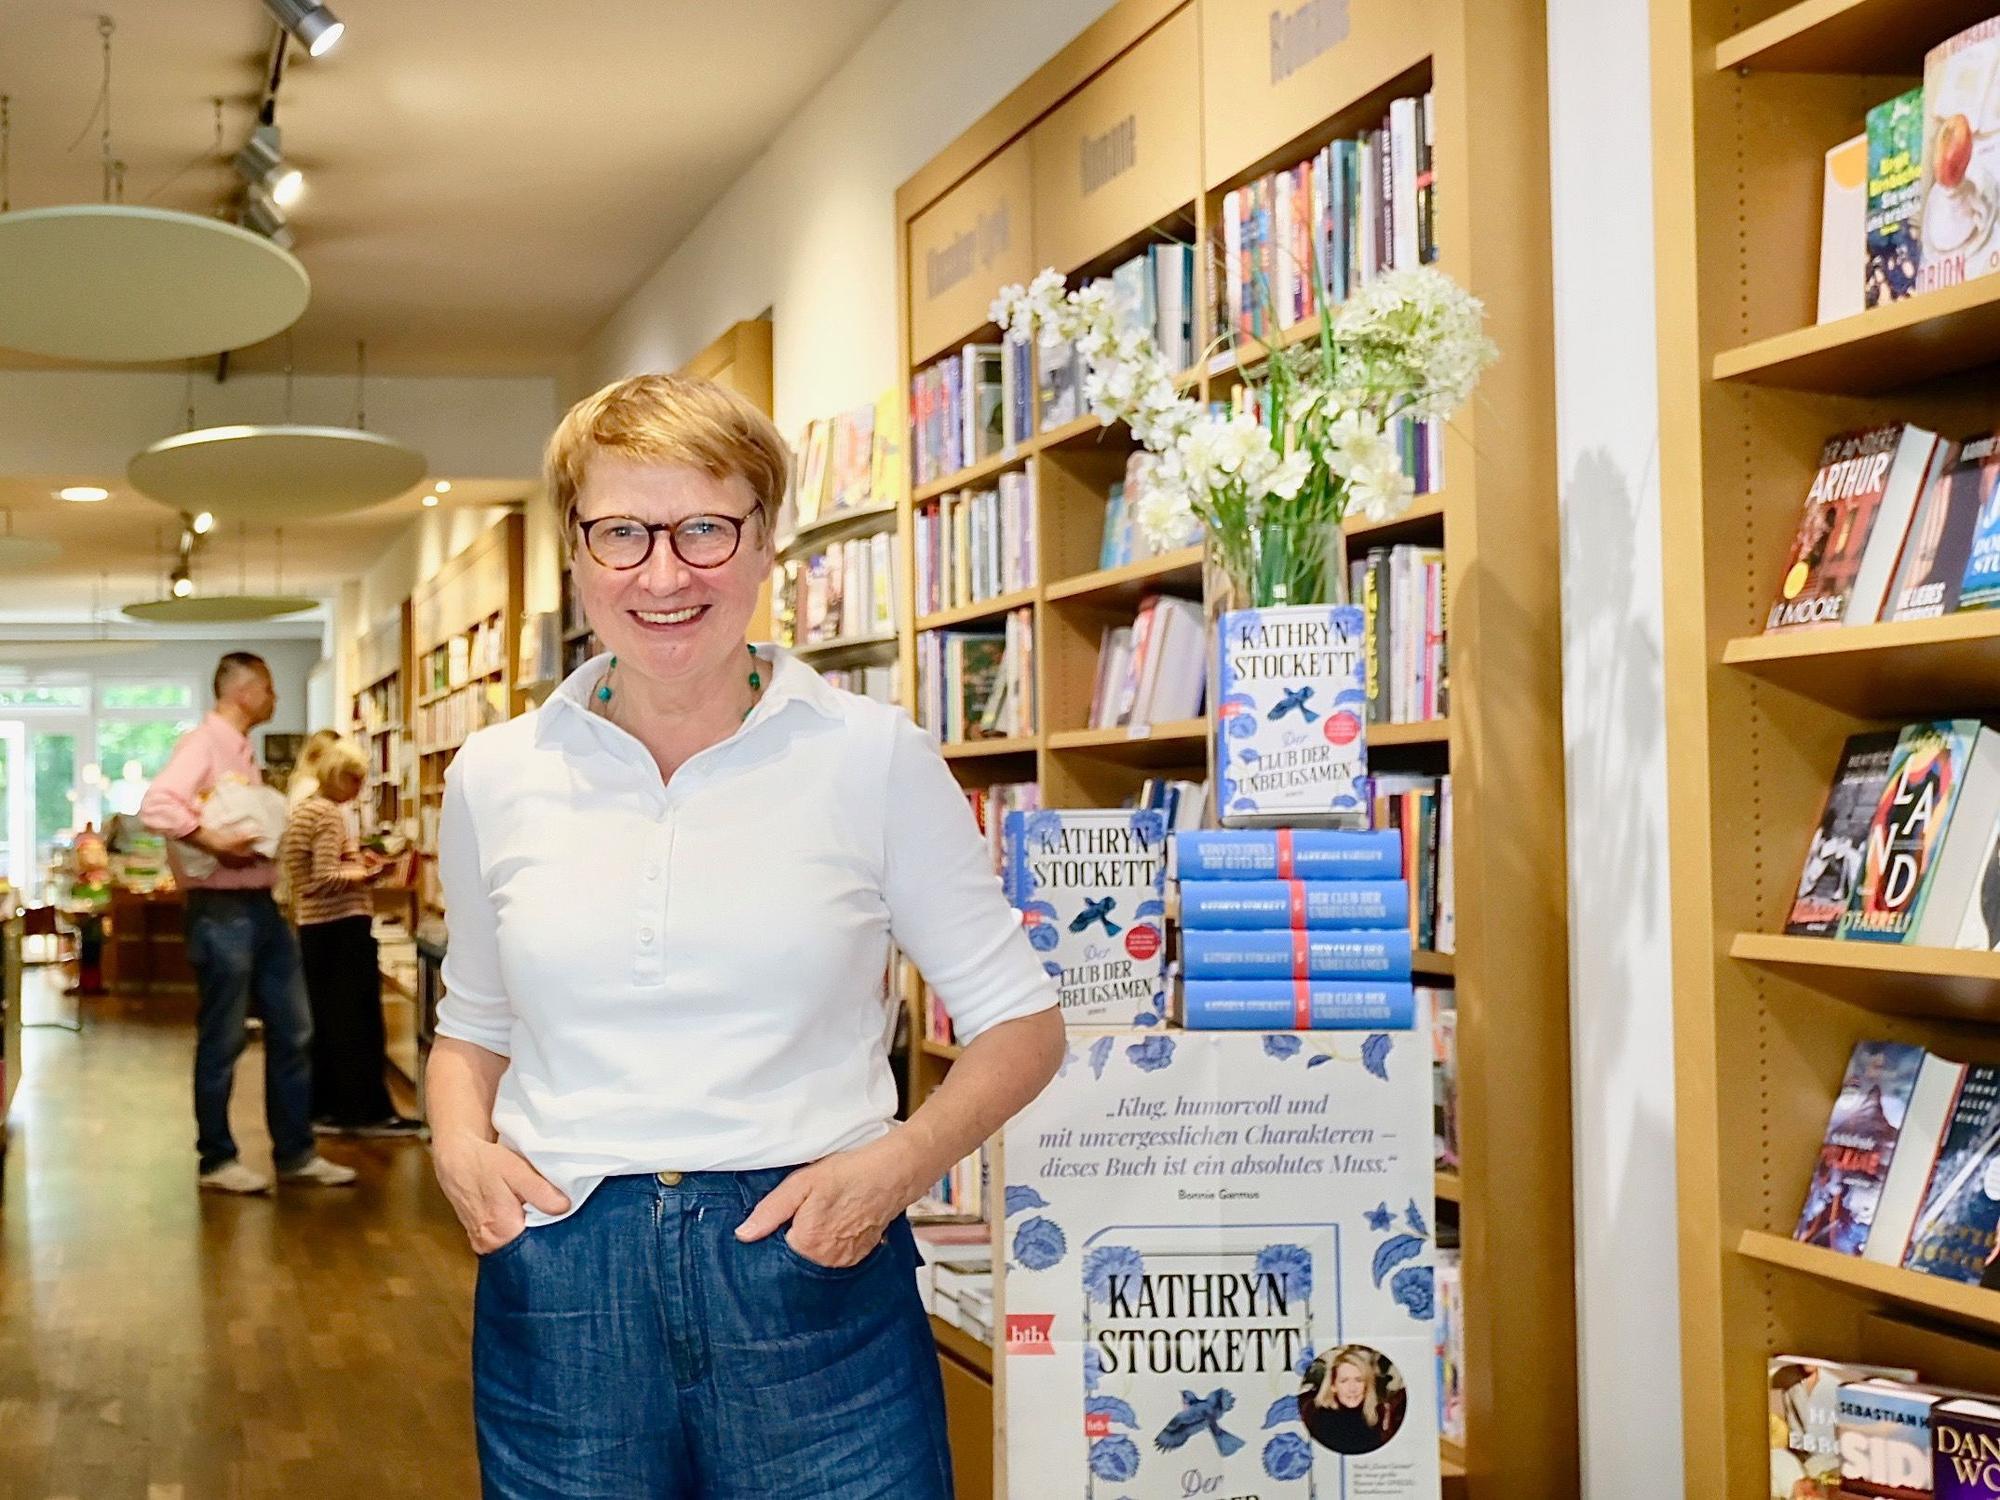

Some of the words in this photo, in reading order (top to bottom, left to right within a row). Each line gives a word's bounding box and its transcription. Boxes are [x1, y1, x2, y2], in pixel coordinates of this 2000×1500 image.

[1804, 451, 1890, 508] ARTHUR
[1242, 620, 1350, 650] KATHRYN
[1235, 652, 1356, 681] STOCKETT
[1258, 749, 1300, 771] CLUB
[1302, 745, 1330, 766] DER
[1239, 763, 1351, 795] UNBEUGSAMEN
[1041, 827, 1150, 855] KATHRYN
[1034, 860, 1156, 888] STOCKETT
[1084, 945, 1110, 962] Der
[1060, 963, 1101, 987] CLUB
[1103, 960, 1132, 980] DER
[1057, 978, 1154, 1009] BEUGSAMEN
[1174, 1094, 1282, 1117] humorvoll
[1287, 1094, 1329, 1115] und
[1039, 1128, 1073, 1148] mit
[1079, 1125, 1238, 1150] unvergesslichen
[1245, 1123, 1374, 1145] Charakteren
[1040, 1157, 1099, 1179] dieses
[1105, 1155, 1157, 1177] Buch
[1163, 1155, 1188, 1176] ist
[1193, 1155, 1225, 1176] ein
[1231, 1153, 1324, 1175] absolutes
[1178, 1189, 1215, 1200] Bonnie
[1219, 1188, 1260, 1200] Garmus
[1108, 1273, 1289, 1319] KATHRYN
[1011, 1322, 1045, 1344] btb
[1098, 1328, 1300, 1374] STOCKETT
[1839, 1401, 1917, 1427] SEBASTIAN
[1181, 1469, 1224, 1498] Der
